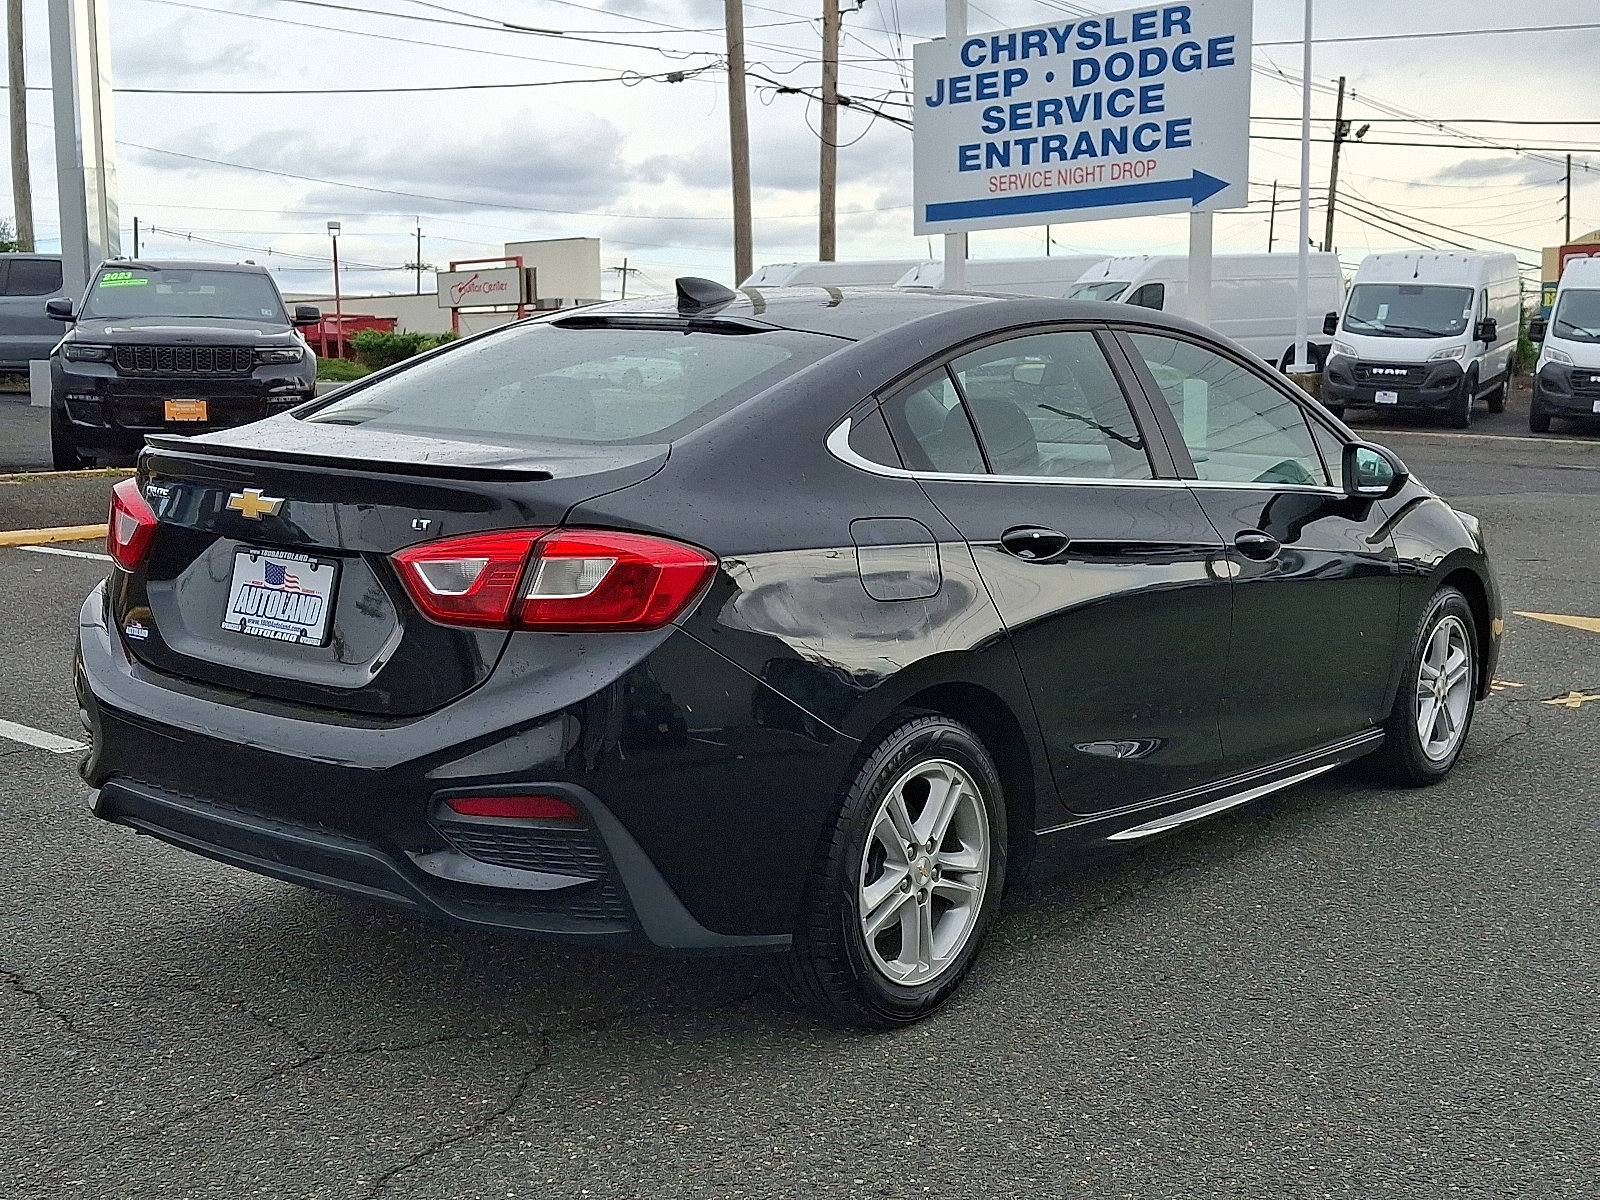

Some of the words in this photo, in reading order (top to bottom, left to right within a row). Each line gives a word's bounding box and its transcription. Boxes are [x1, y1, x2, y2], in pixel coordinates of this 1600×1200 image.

[961, 5, 1191, 68] CHRYSLER
[925, 68, 1028, 107] JEEP
[1072, 35, 1235, 87] DODGE
[981, 83, 1165, 134] SERVICE
[958, 117, 1192, 172] ENTRANCE
[989, 169, 1052, 193] SERVICE
[1058, 165, 1106, 186] NIGHT
[1110, 159, 1157, 180] DROP
[103, 272, 133, 281] 2023
[412, 519, 431, 530] LT
[233, 584, 323, 626] AUTOLAND
[244, 626, 297, 642] AUTOLAND
